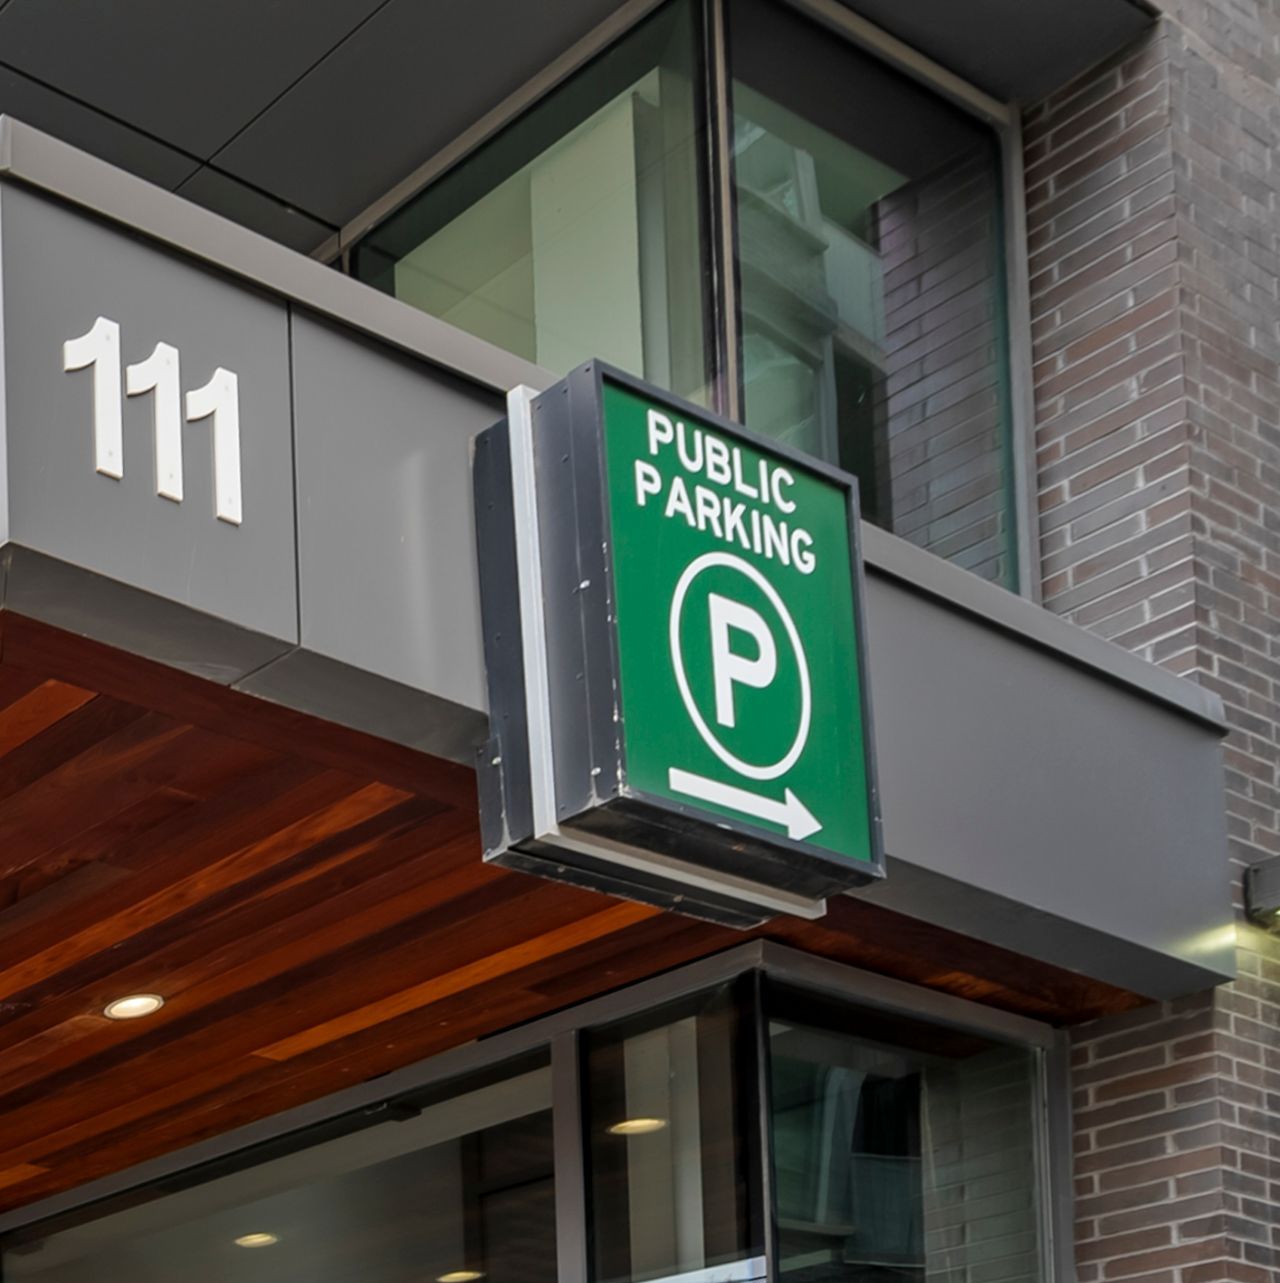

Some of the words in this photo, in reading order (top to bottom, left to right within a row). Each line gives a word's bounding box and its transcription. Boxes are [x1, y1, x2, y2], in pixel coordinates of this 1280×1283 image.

[64, 316, 243, 526] 111
[647, 409, 797, 515] PUBLIC
[634, 460, 817, 575] PARKING
[708, 592, 778, 729] P
